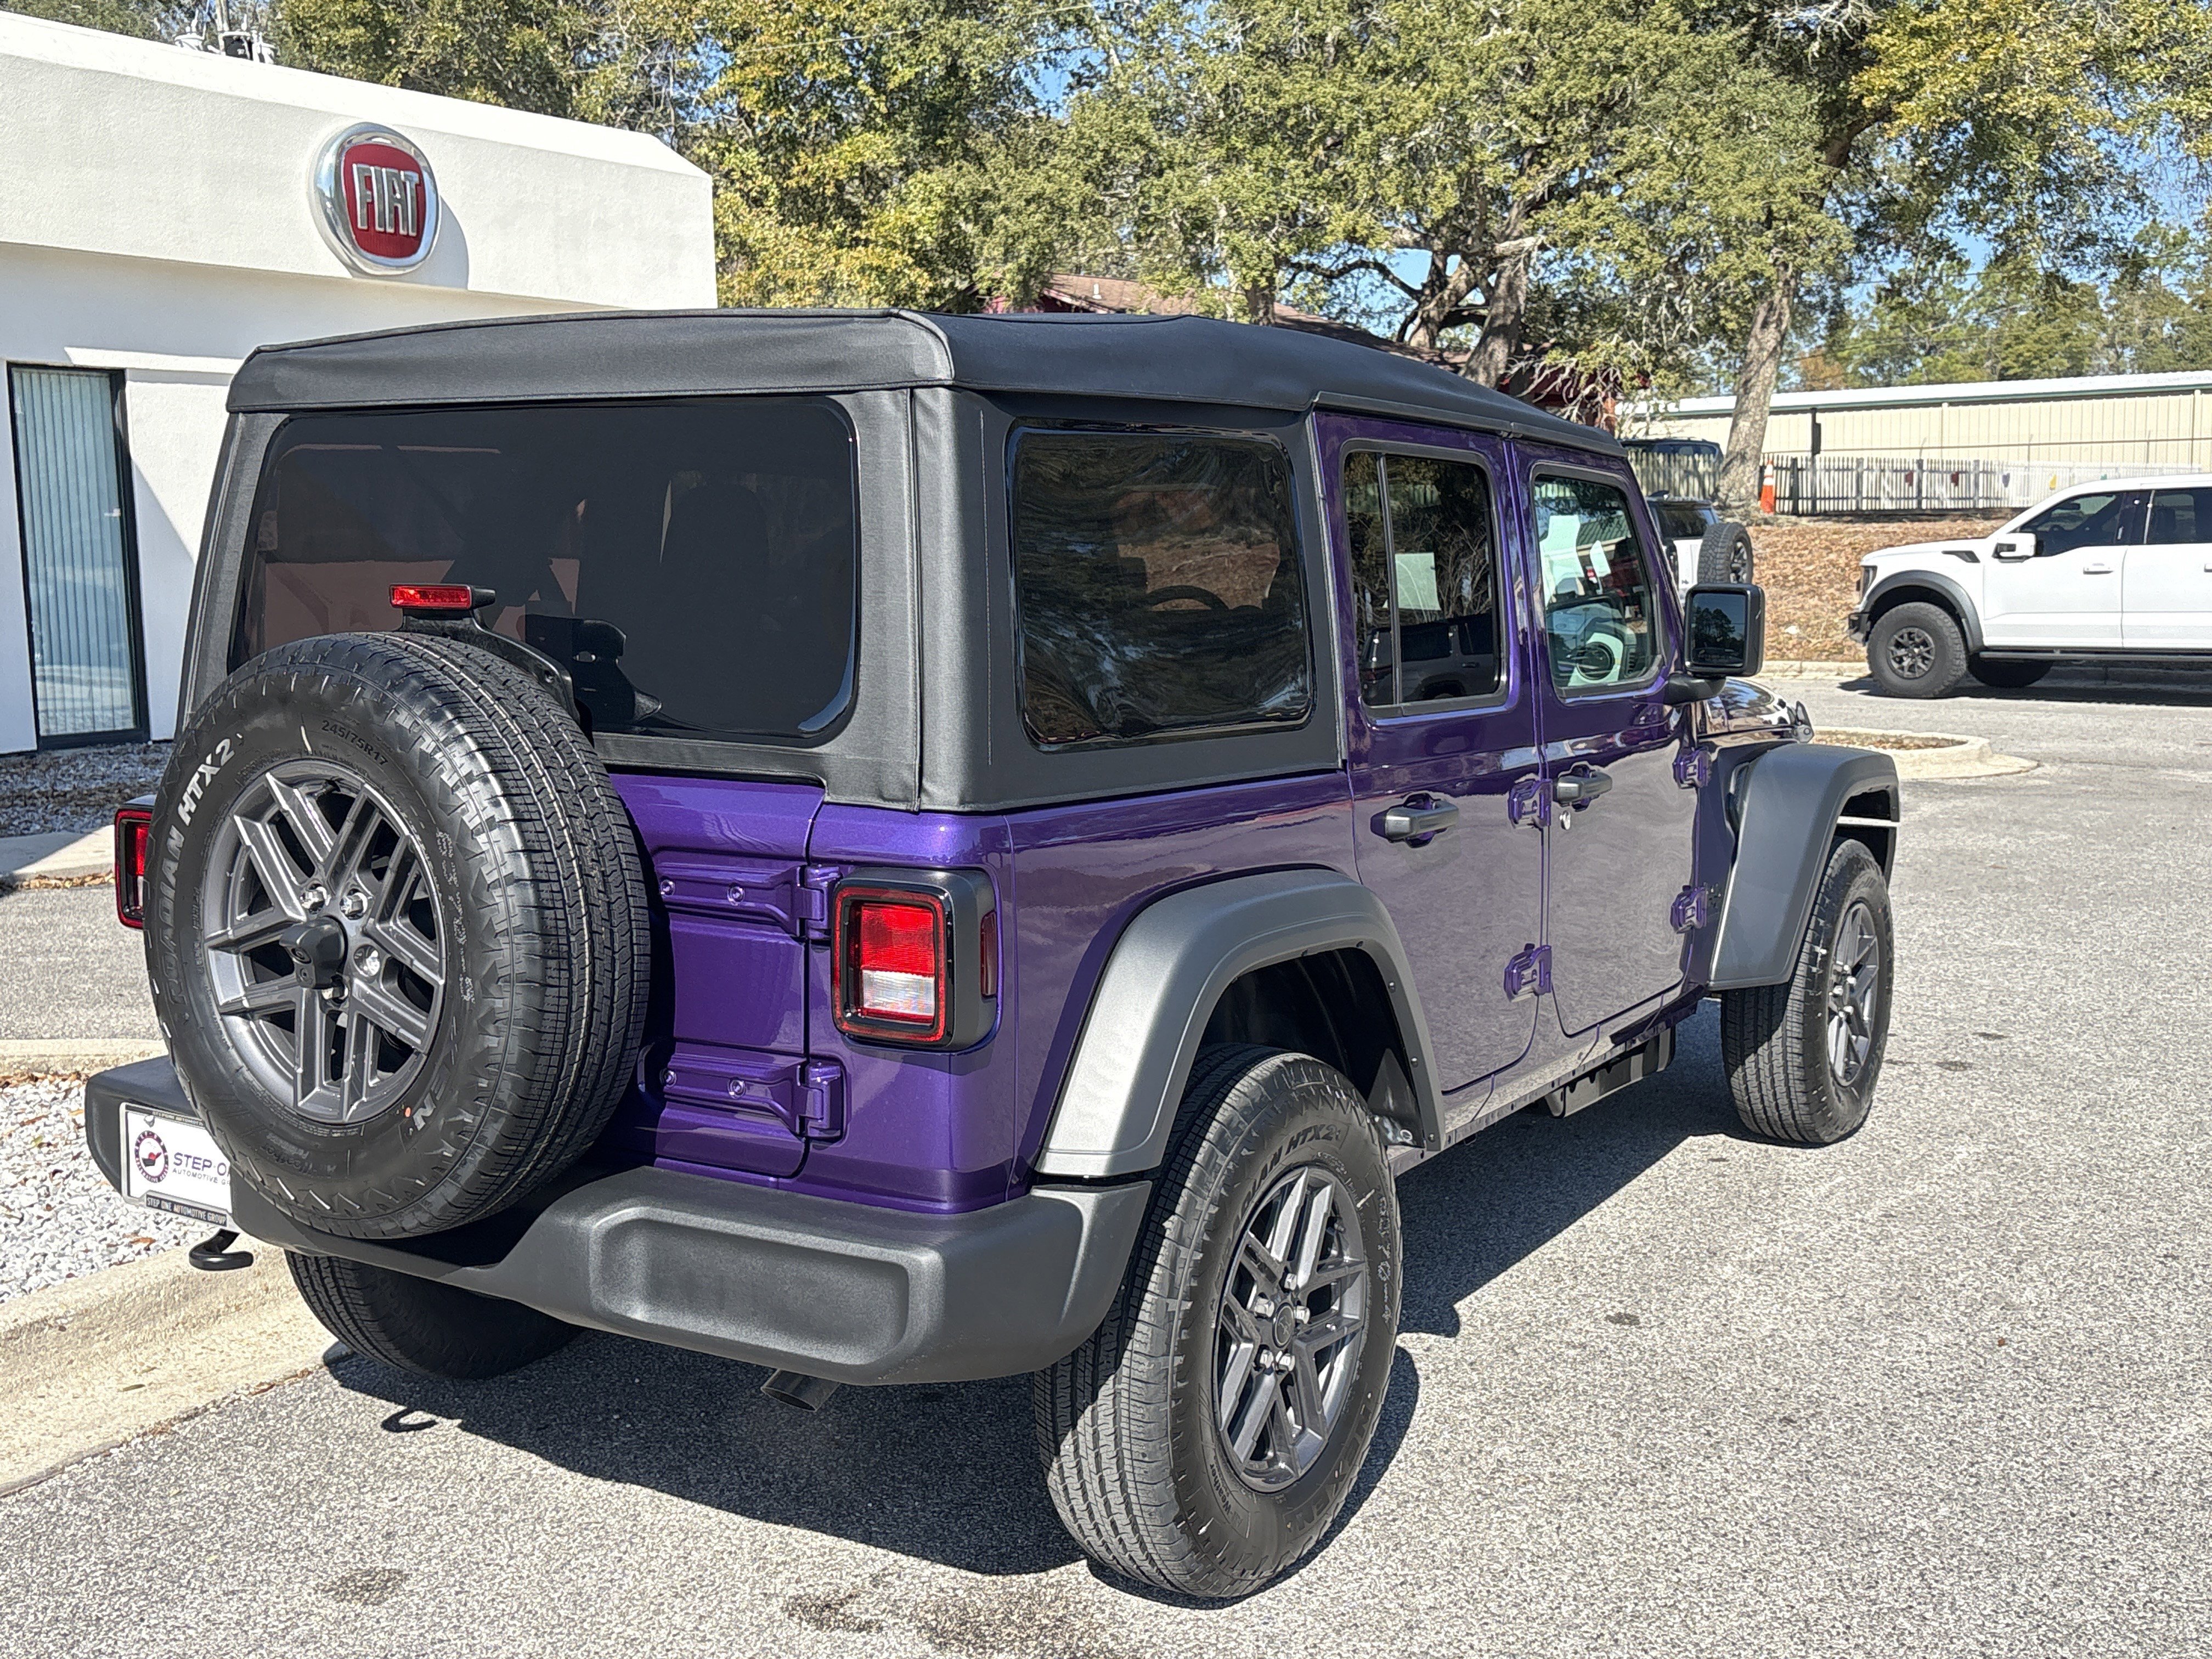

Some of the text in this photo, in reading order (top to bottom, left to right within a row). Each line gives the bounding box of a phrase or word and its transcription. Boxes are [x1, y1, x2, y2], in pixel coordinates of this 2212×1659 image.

[352, 163, 420, 237] FIAT
[321, 719, 388, 766] 245/75R17
[173, 1152, 213, 1171] STEP
[172, 1167, 218, 1184] AUTOMOTIVE
[147, 1197, 226, 1224] STEP ONE AUTOMOTIVE GROUP
